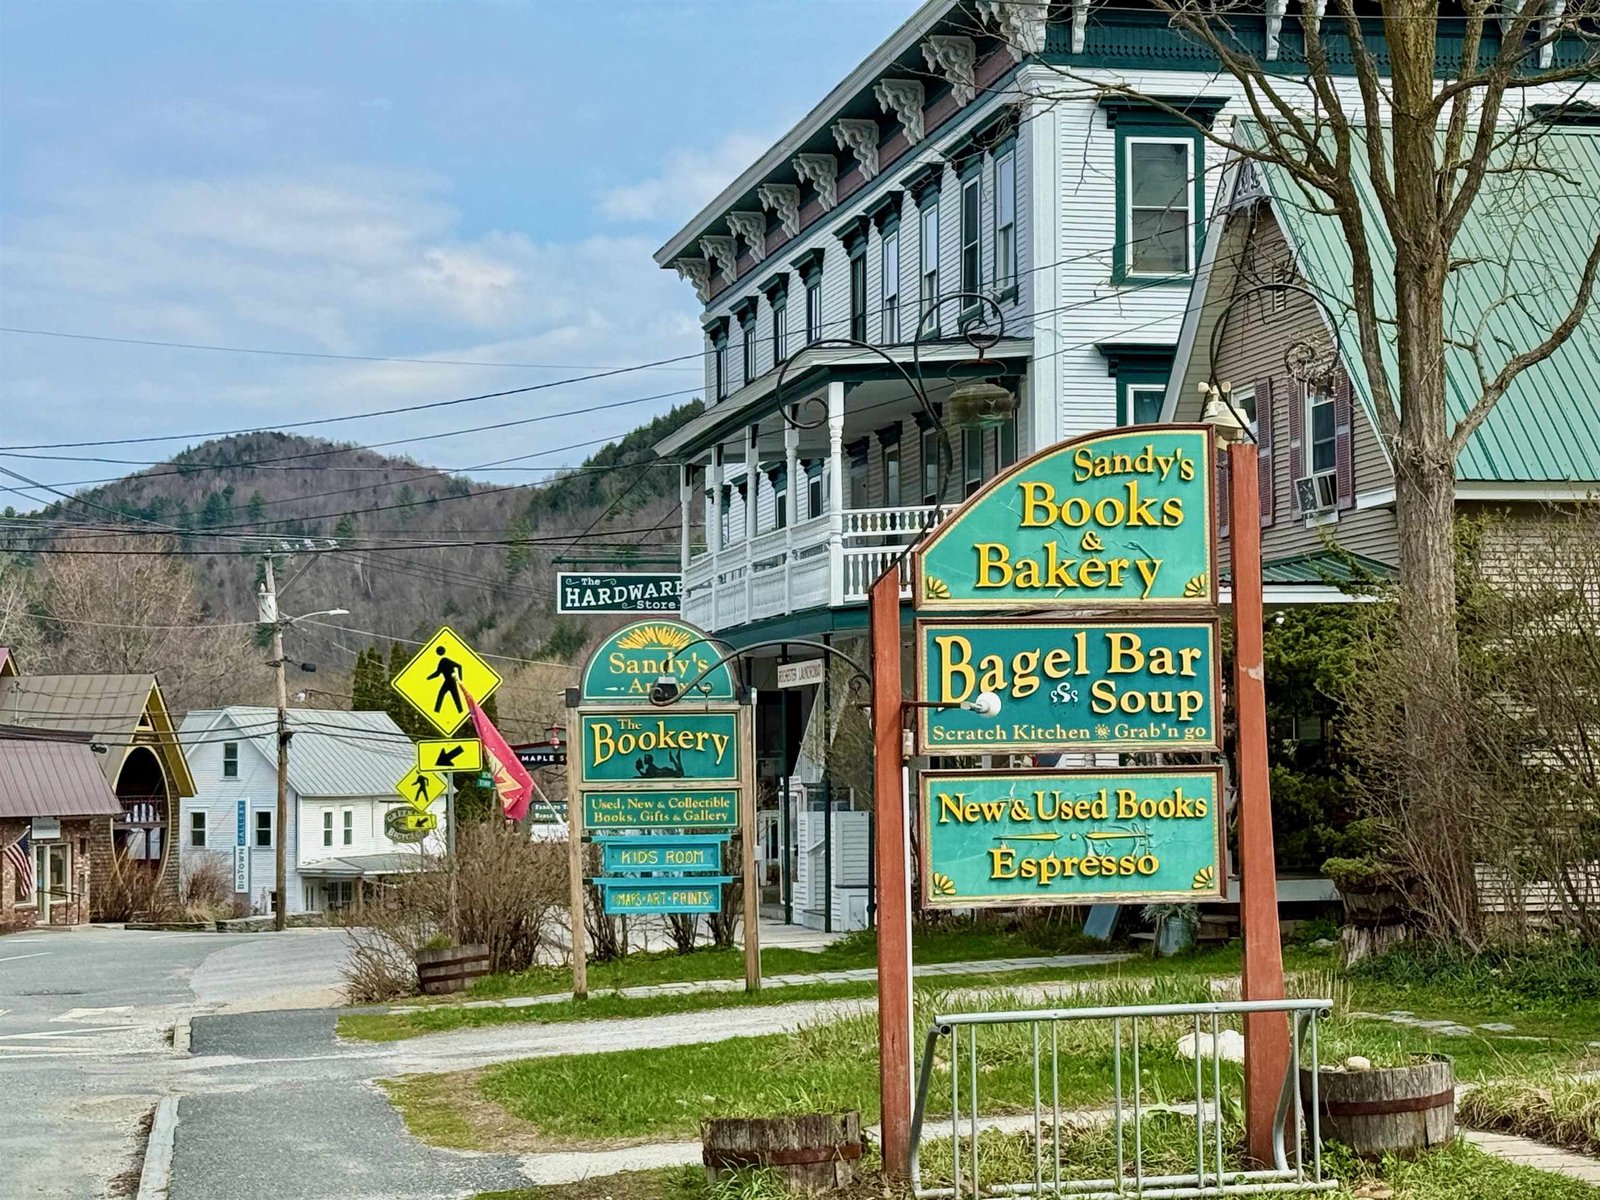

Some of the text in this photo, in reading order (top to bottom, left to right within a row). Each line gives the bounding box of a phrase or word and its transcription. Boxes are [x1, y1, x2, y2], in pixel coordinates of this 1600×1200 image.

[1073, 444, 1195, 482] Sandy's
[1018, 480, 1185, 528] Books
[1081, 529, 1105, 551] &
[581, 577, 600, 586] The
[973, 541, 1163, 600] Bakery
[636, 600, 676, 609] Store
[609, 652, 709, 679] Sandy's
[935, 631, 1202, 712] Bagel Bar
[1091, 679, 1204, 721] Soup
[618, 719, 642, 730] The
[932, 723, 1206, 741] Scratch Kitchen Grab'n go
[591, 721, 729, 767] Bookery
[592, 797, 730, 810] Used, New & Collectible
[938, 787, 1208, 823] New & Used Books
[594, 811, 636, 823] Books,
[640, 811, 670, 821] Gifts
[683, 810, 728, 822] Gallery
[621, 850, 704, 864] KIDS ROOM
[988, 848, 1160, 885] Espresso
[646, 892, 667, 905] ART
[672, 891, 711, 905] PRINTS
